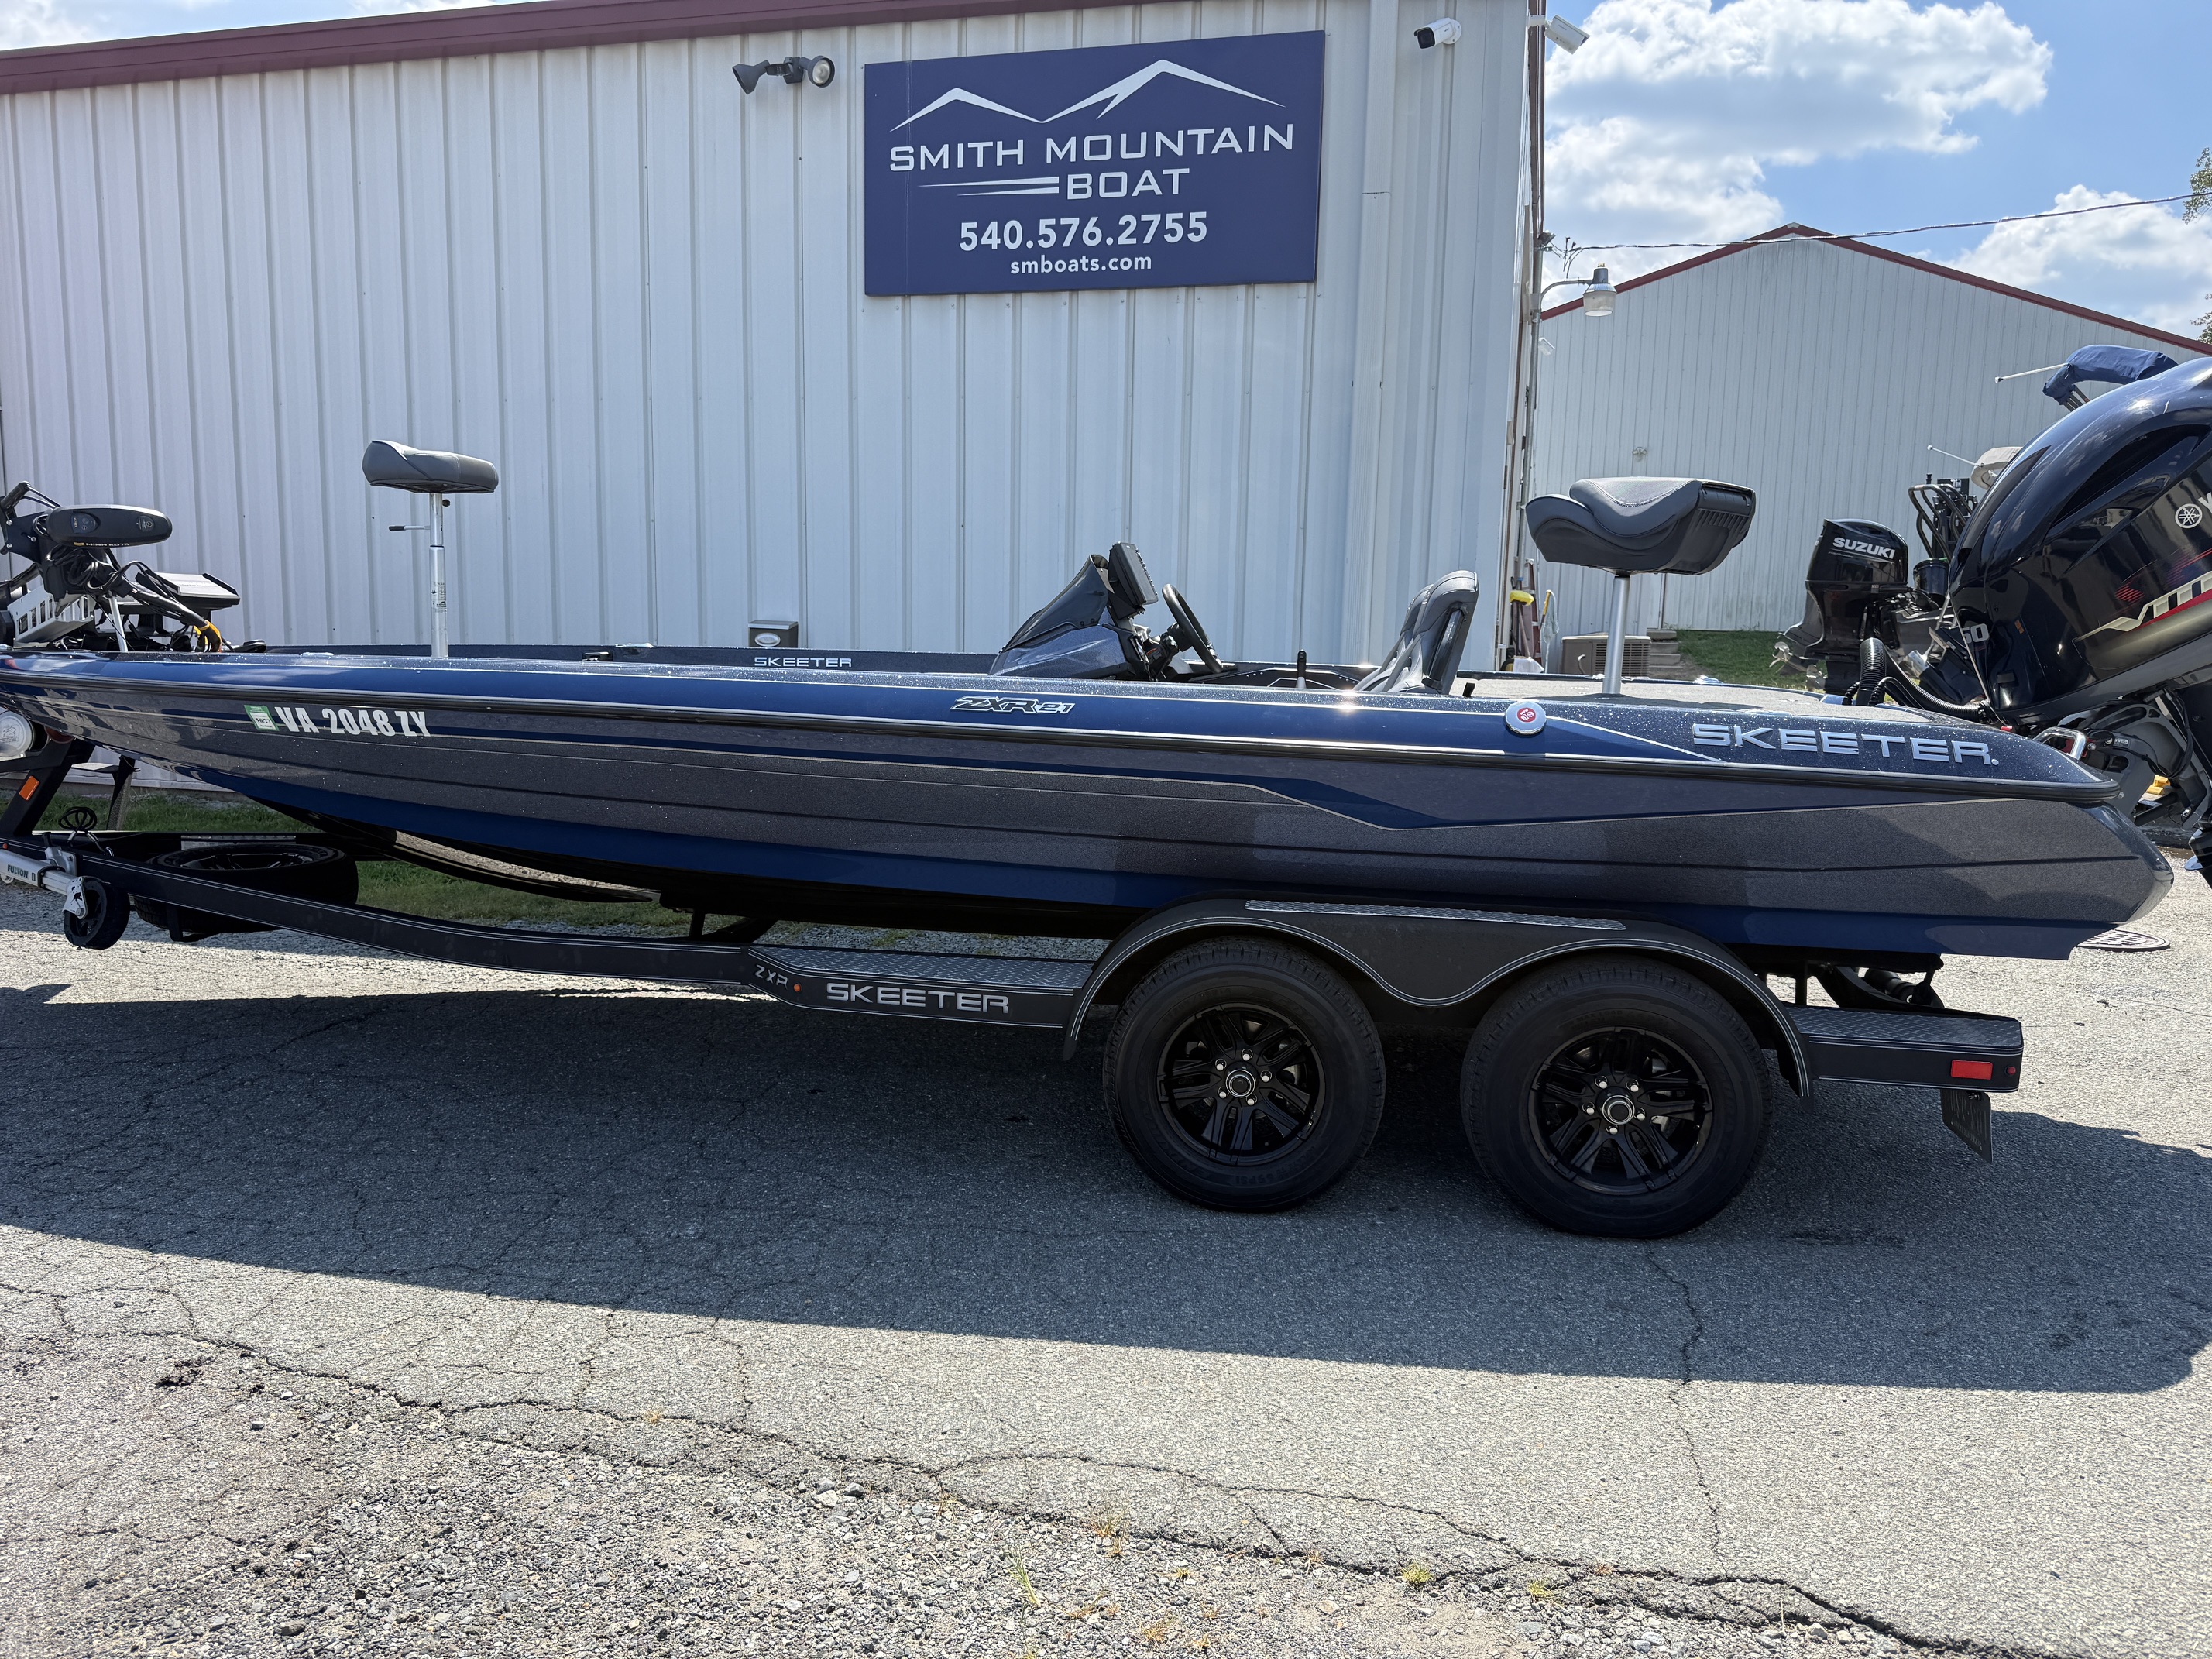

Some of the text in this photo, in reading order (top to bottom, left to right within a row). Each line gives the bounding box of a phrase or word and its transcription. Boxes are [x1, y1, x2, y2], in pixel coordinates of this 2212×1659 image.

[890, 123, 1293, 171] SMITH MOUNTAIN
[1067, 167, 1190, 200] BOAT
[959, 211, 1207, 251] 540.576.2755
[1010, 255, 1152, 274] smboats.com
[1832, 537, 1896, 559] SUZUKI
[754, 657, 852, 668] SKEETER
[274, 706, 431, 737] VA 2048 ZY
[1692, 723, 1993, 765] SKEETER
[8, 864, 29, 878] FULTON
[754, 963, 788, 990] ZXR
[826, 982, 1009, 1014] SKEETER
